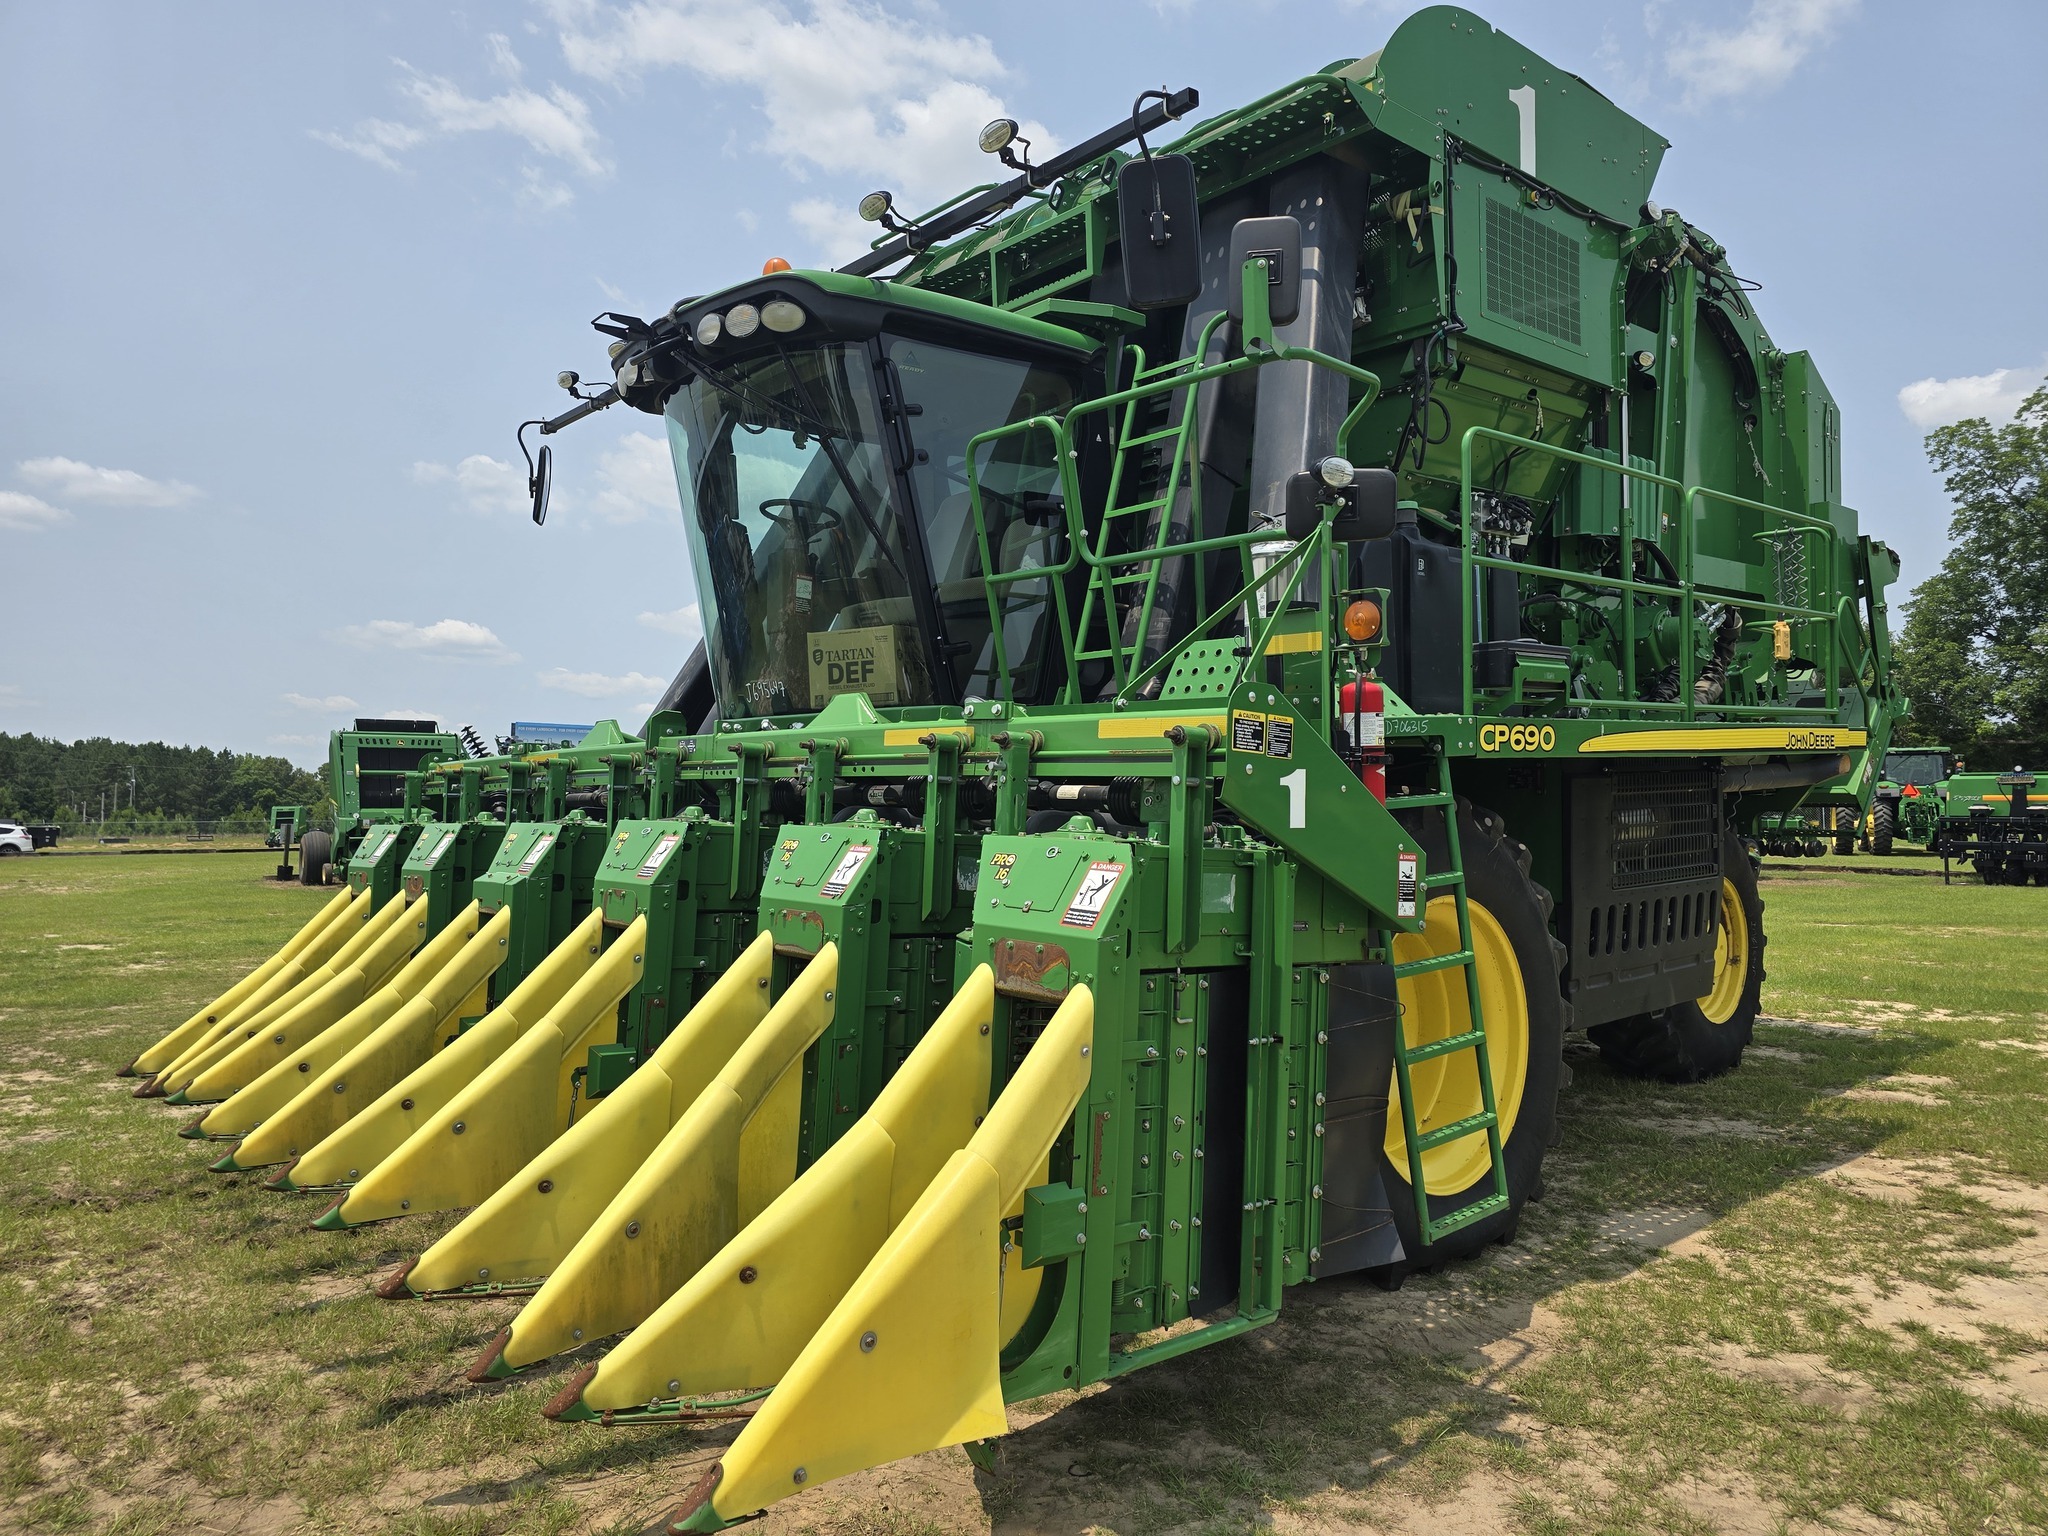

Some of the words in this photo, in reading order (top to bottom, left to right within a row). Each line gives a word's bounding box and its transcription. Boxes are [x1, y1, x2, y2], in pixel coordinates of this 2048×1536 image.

[1508, 85, 1536, 178] 1
[826, 647, 875, 661] TARTAN
[828, 660, 874, 684] DEF
[1386, 719, 1429, 735] D706315
[1480, 725, 1556, 752] CP690
[1786, 732, 1808, 748] JOHN
[1809, 731, 1835, 747] DEERE
[1280, 769, 1306, 829] 1
[780, 839, 800, 850] PRO
[990, 853, 1017, 865] PRO
[1097, 863, 1123, 871] DANGER
[994, 867, 1010, 880] 16
